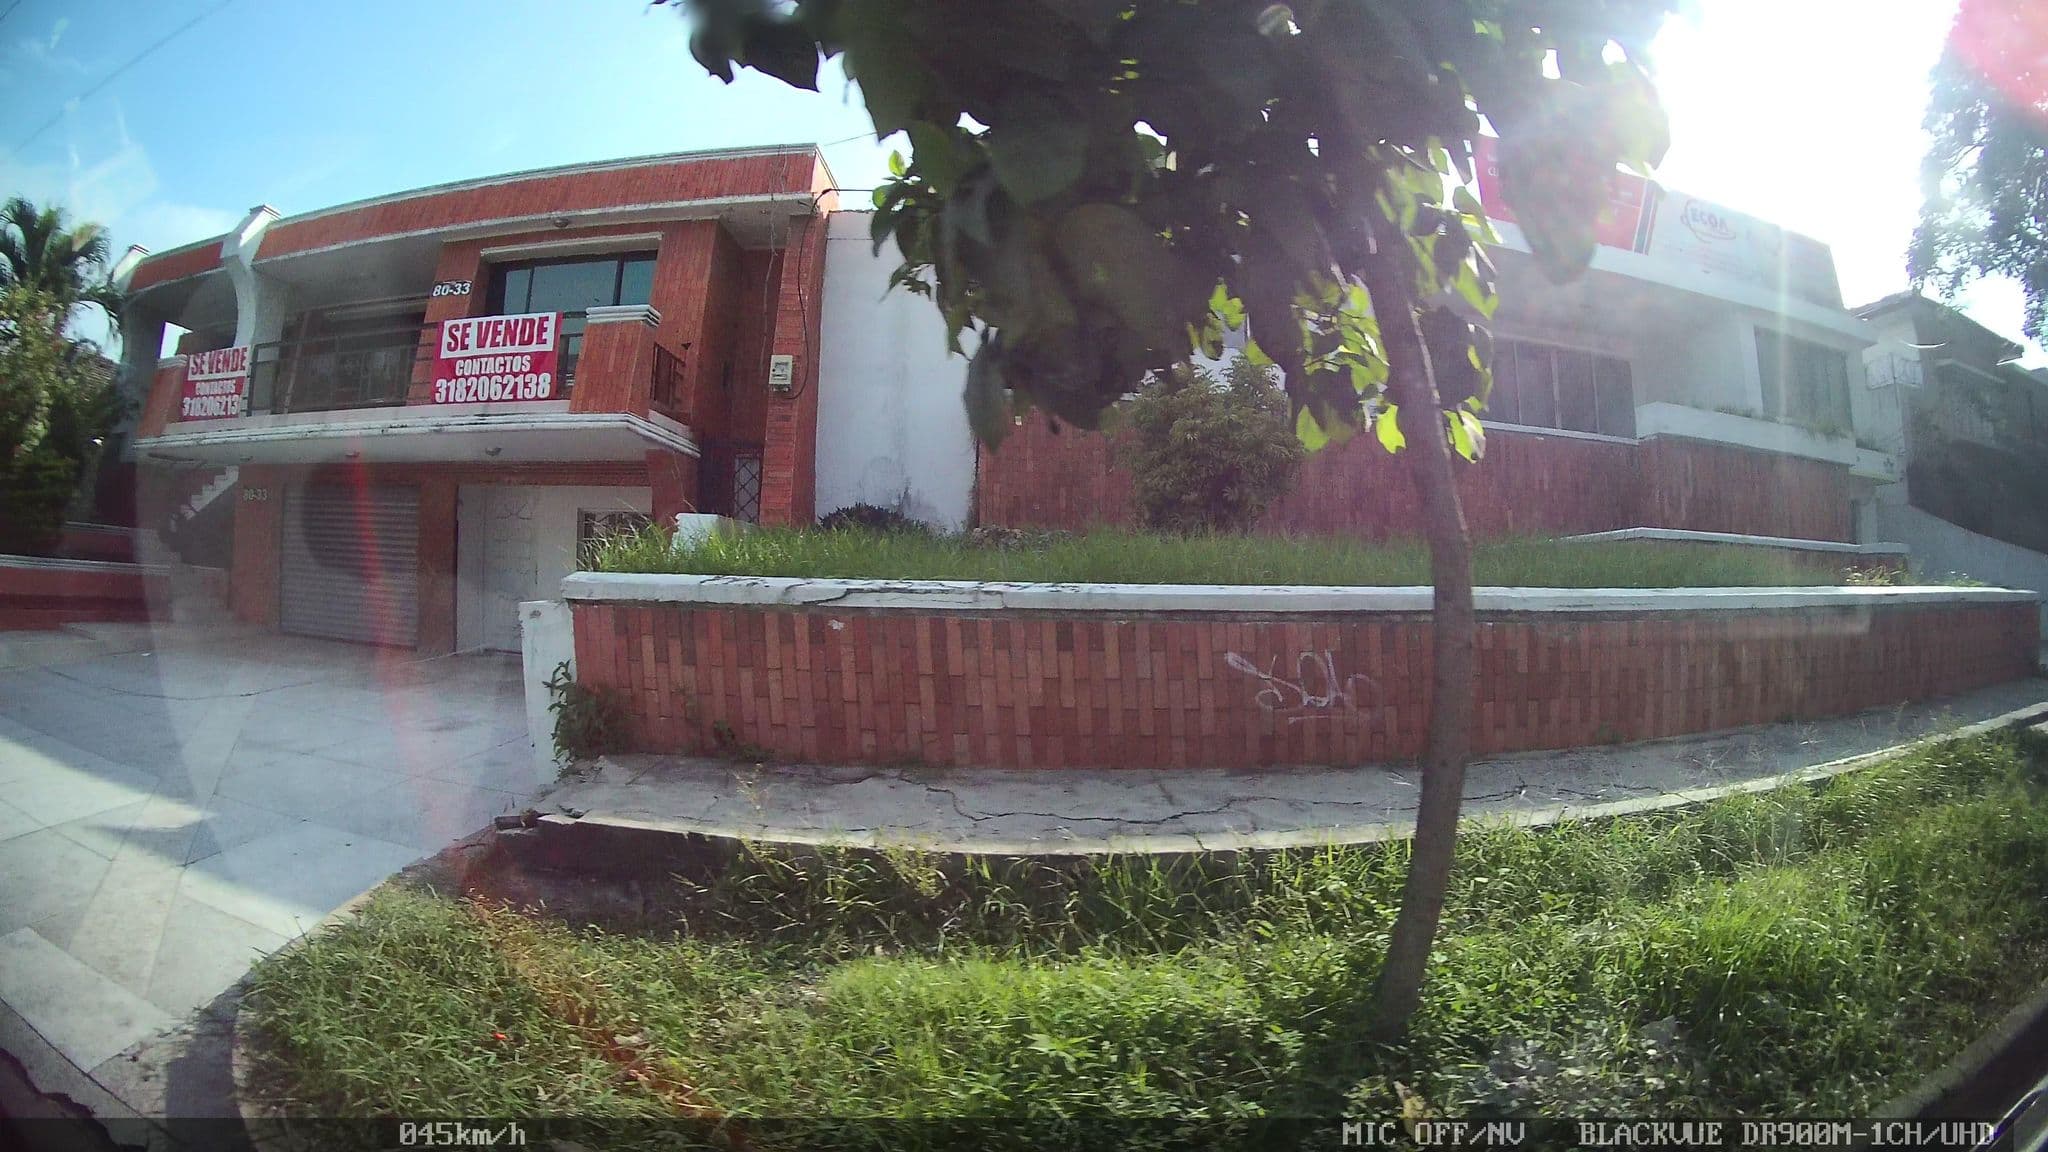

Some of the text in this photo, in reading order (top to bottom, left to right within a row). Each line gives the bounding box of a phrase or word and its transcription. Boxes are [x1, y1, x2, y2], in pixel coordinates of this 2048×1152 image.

[433, 283, 471, 297] 80-33
[446, 316, 550, 352] SE VENDE
[191, 347, 248, 376] SE VENDE
[455, 355, 531, 377] CONTACTOS
[435, 373, 551, 403] 3182062138
